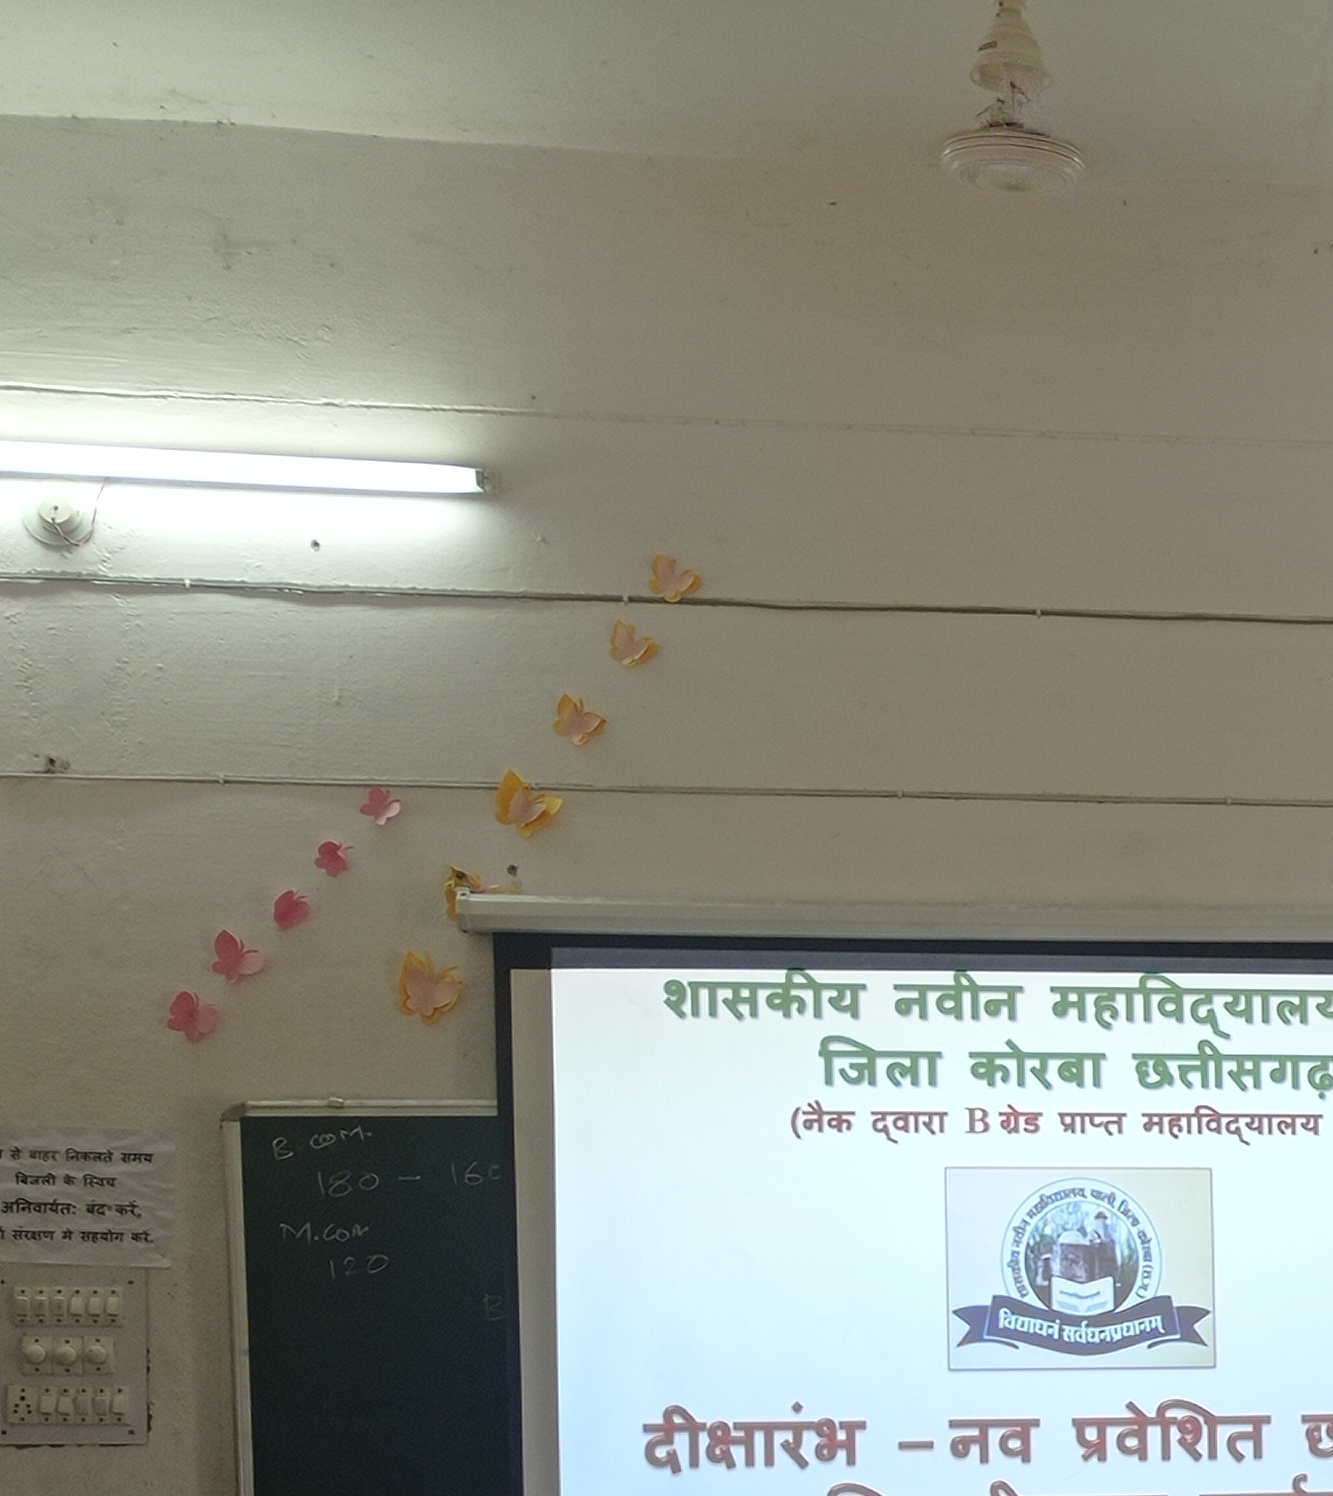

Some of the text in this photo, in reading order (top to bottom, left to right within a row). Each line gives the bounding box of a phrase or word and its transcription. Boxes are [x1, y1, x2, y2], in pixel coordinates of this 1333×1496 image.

[663, 968, 867, 1020] शासकीय
[893, 969, 1024, 1021] नवीन
[818, 1035, 942, 1087] जिला
[968, 1038, 1106, 1090] कोरबा
[964, 1106, 990, 1134] B
[1058, 1111, 1127, 1136] प्राप्त
[65, 1147, 114, 1163] निकलते
[121, 1152, 154, 1164] समय
[15, 1171, 56, 1186] बिजली
[63, 1173, 77, 1186] के
[642, 1401, 867, 1475] दीक्षारंभ
[948, 1417, 1041, 1465] नव
[1072, 1398, 1272, 1463] प्रवेशित
